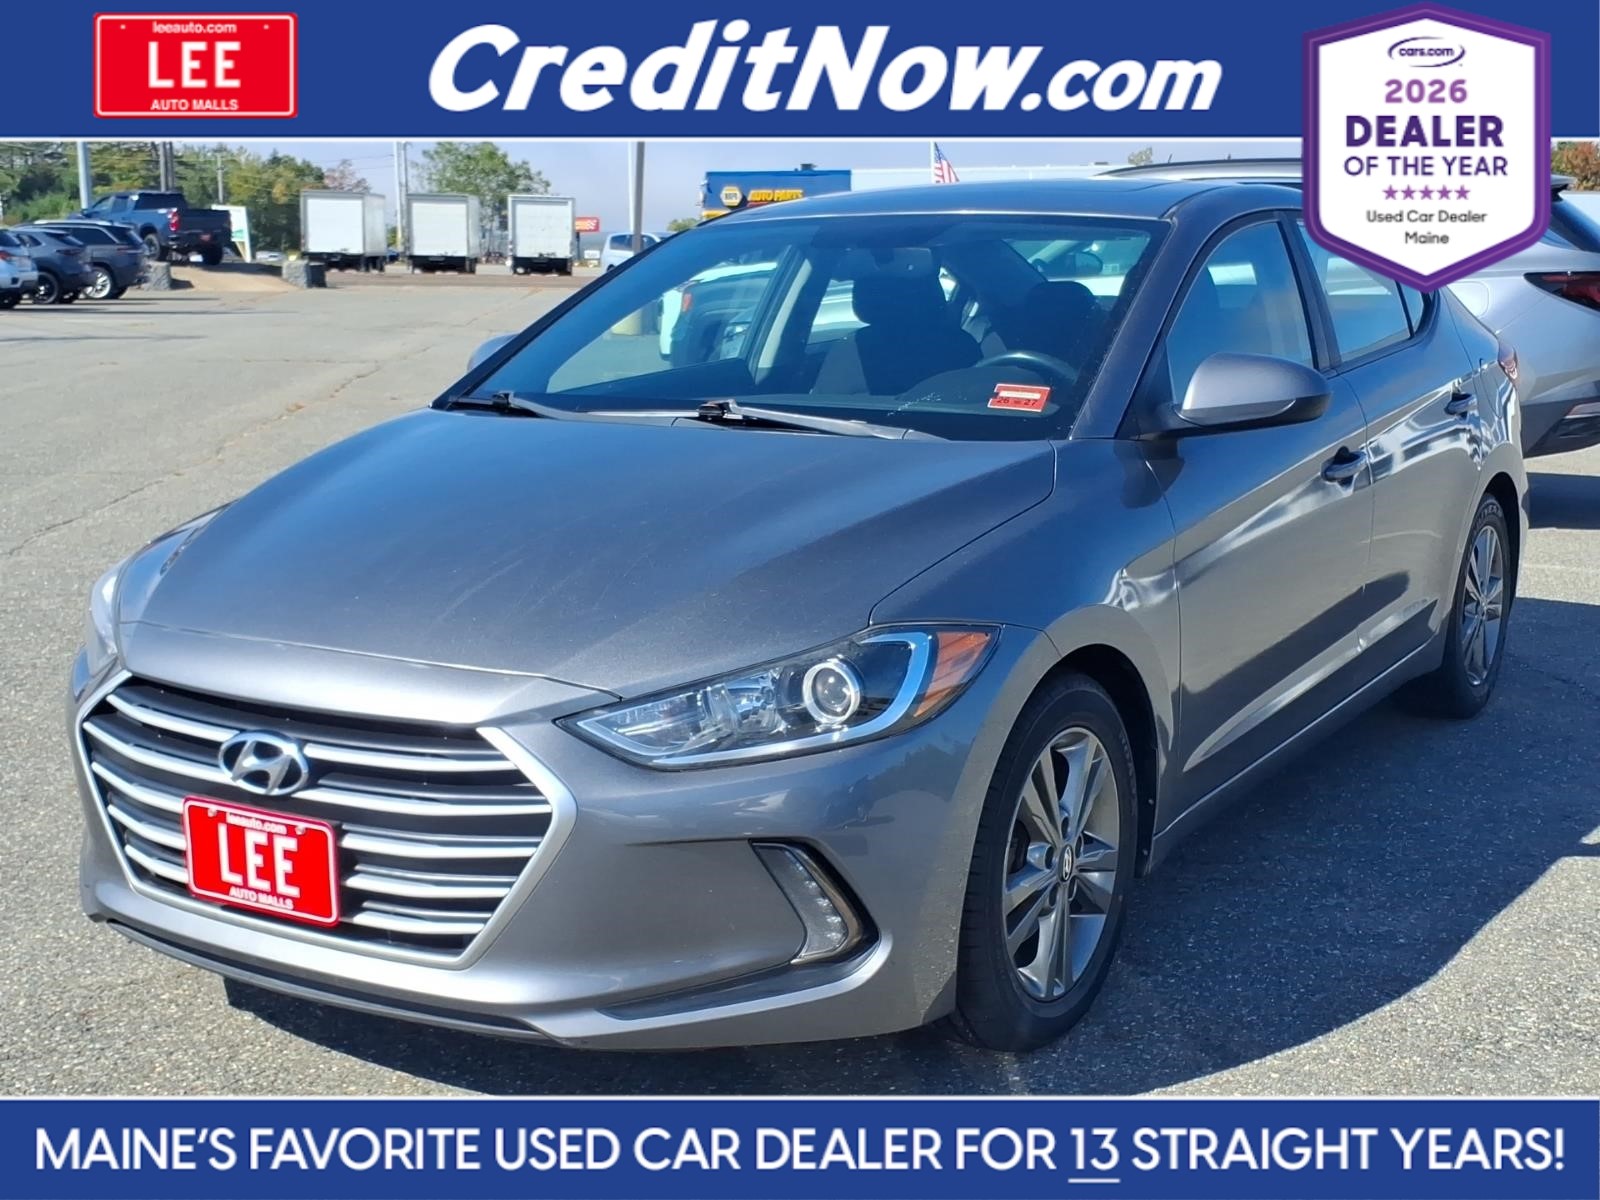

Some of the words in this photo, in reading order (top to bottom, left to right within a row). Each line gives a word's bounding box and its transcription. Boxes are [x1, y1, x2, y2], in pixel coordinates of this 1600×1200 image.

[747, 189, 774, 202] AUTO
[774, 189, 803, 202] PARTS
[217, 822, 301, 898] LEE
[228, 886, 258, 902] AUTO
[257, 892, 294, 910] MALLS
